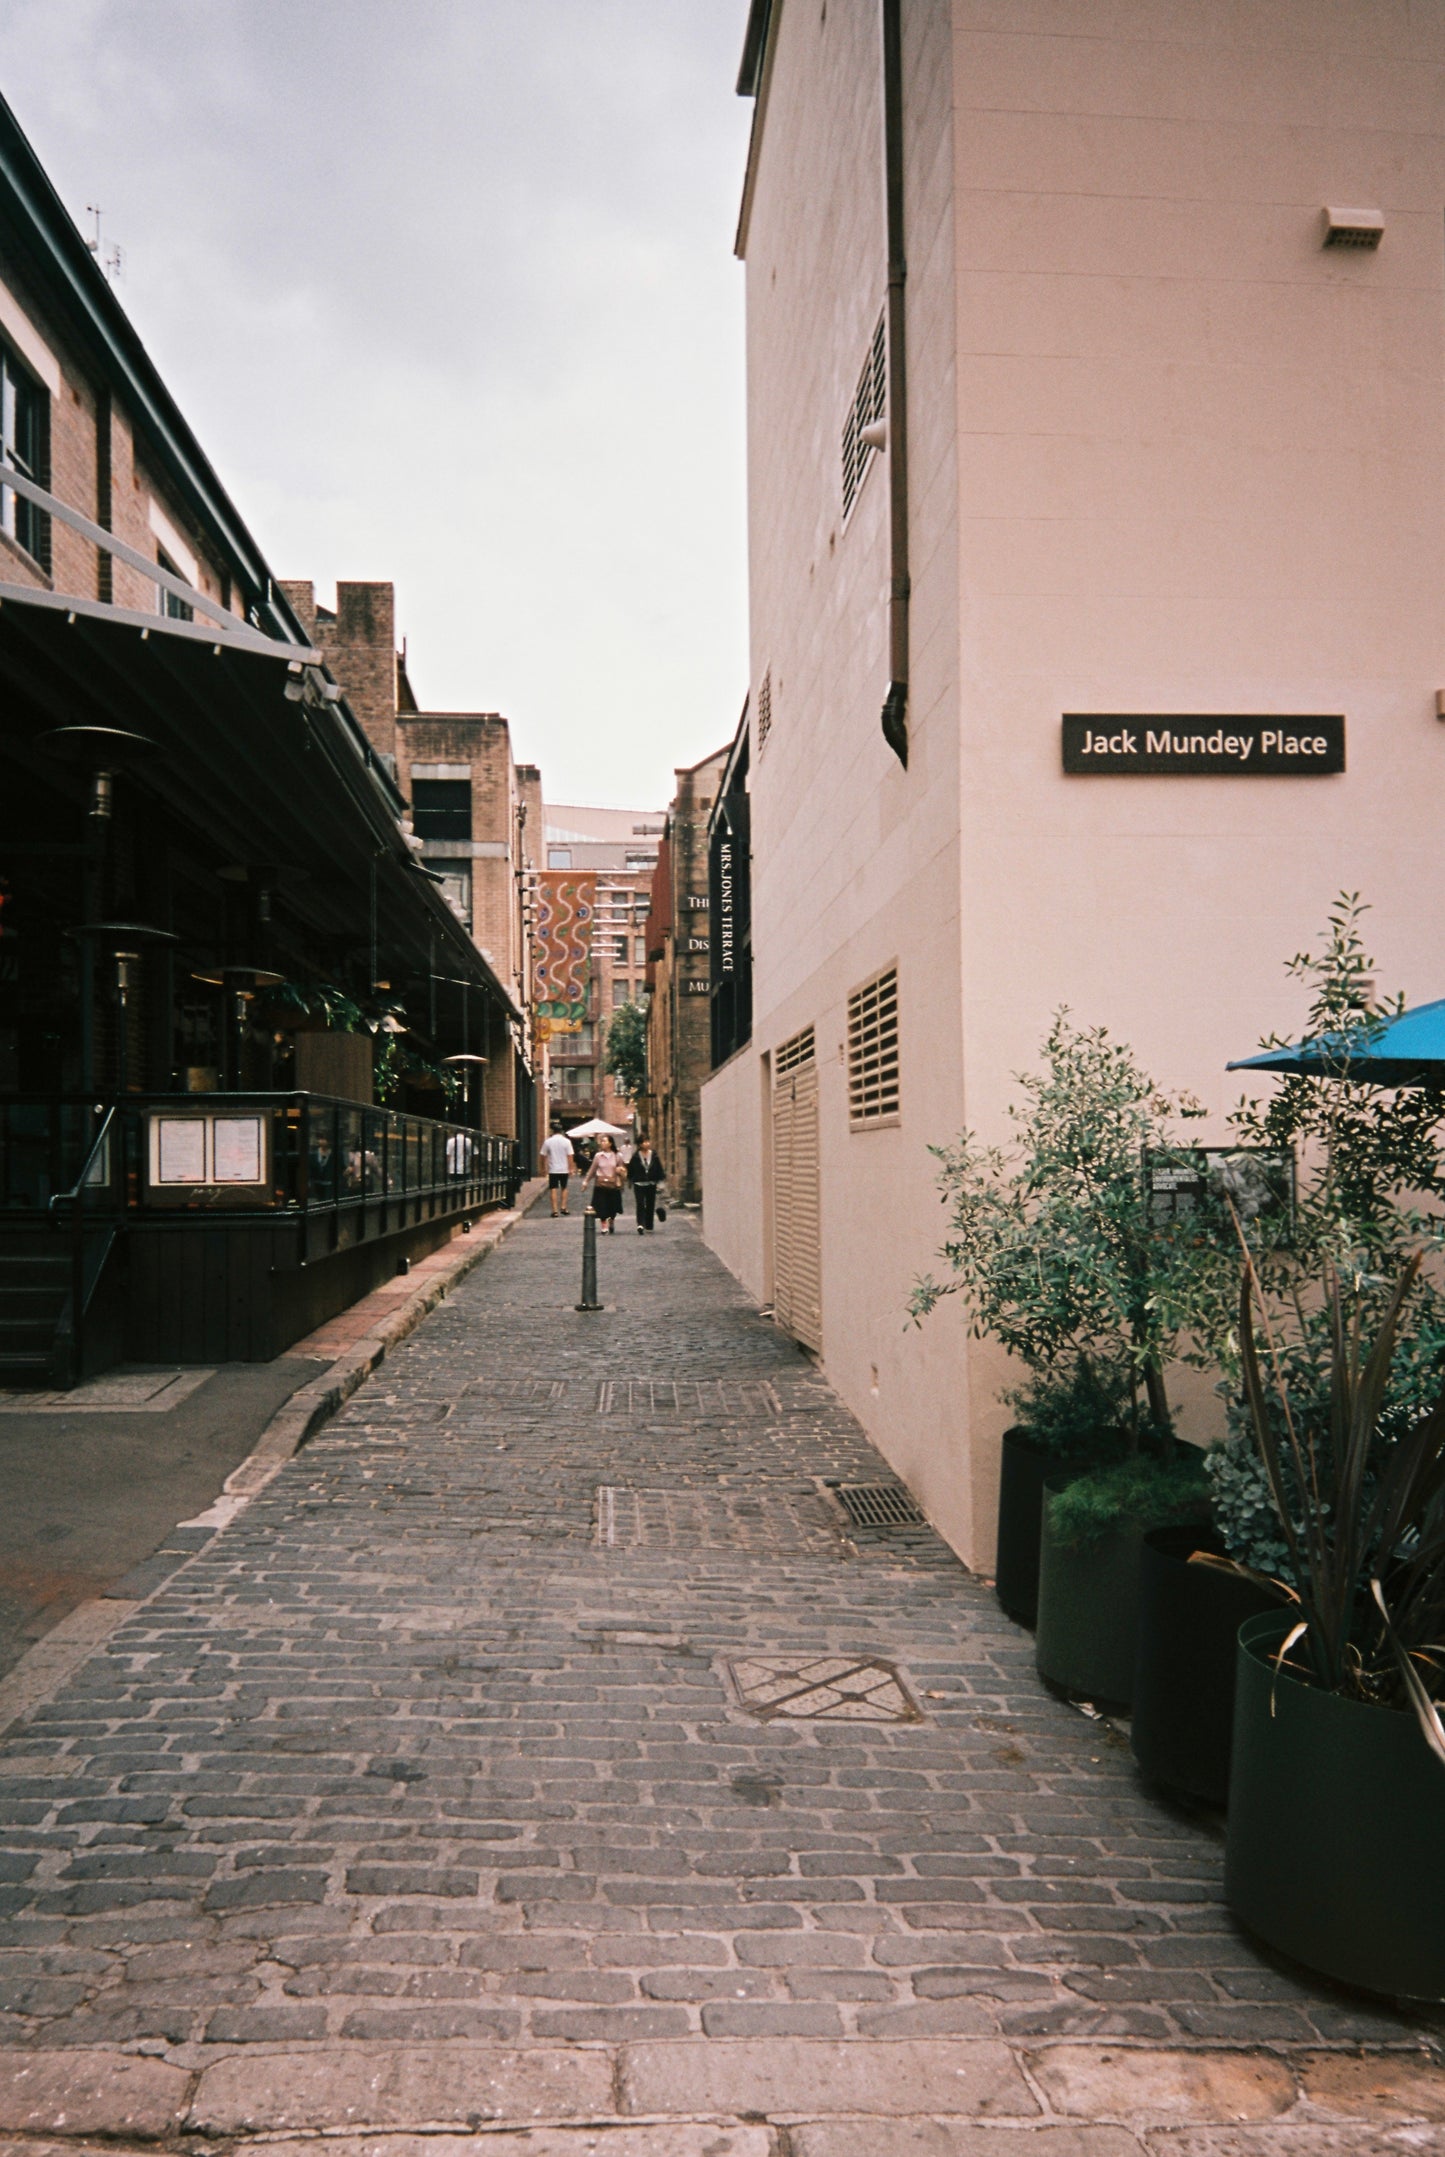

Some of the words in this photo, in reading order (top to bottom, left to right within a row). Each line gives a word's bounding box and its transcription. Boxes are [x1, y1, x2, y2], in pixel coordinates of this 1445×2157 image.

[1082, 728, 1138, 754] Jack
[1146, 729, 1254, 760] Mundey
[1261, 729, 1328, 755] Place
[721, 915, 734, 972] TERRACE
